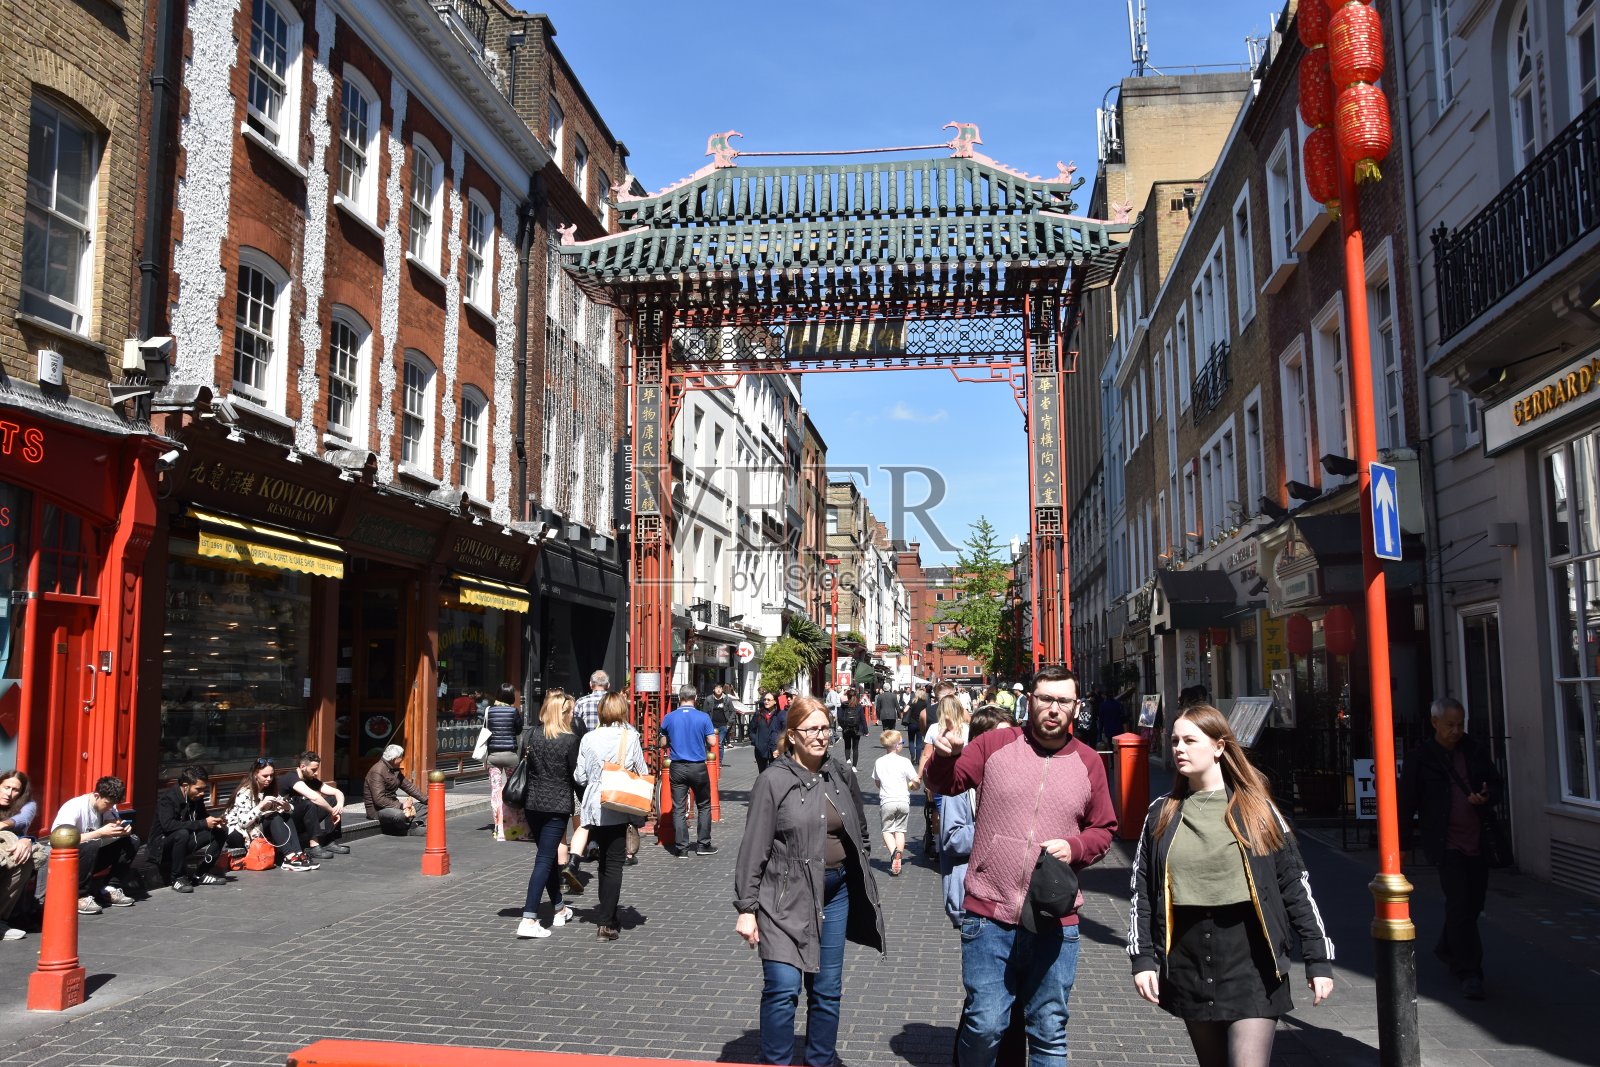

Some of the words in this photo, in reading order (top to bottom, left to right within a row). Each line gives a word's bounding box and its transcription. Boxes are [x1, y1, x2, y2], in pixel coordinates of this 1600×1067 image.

[258, 475, 338, 515] KOWLOON
[267, 502, 317, 524] RESTAURANT
[453, 536, 502, 561] KOWLOON
